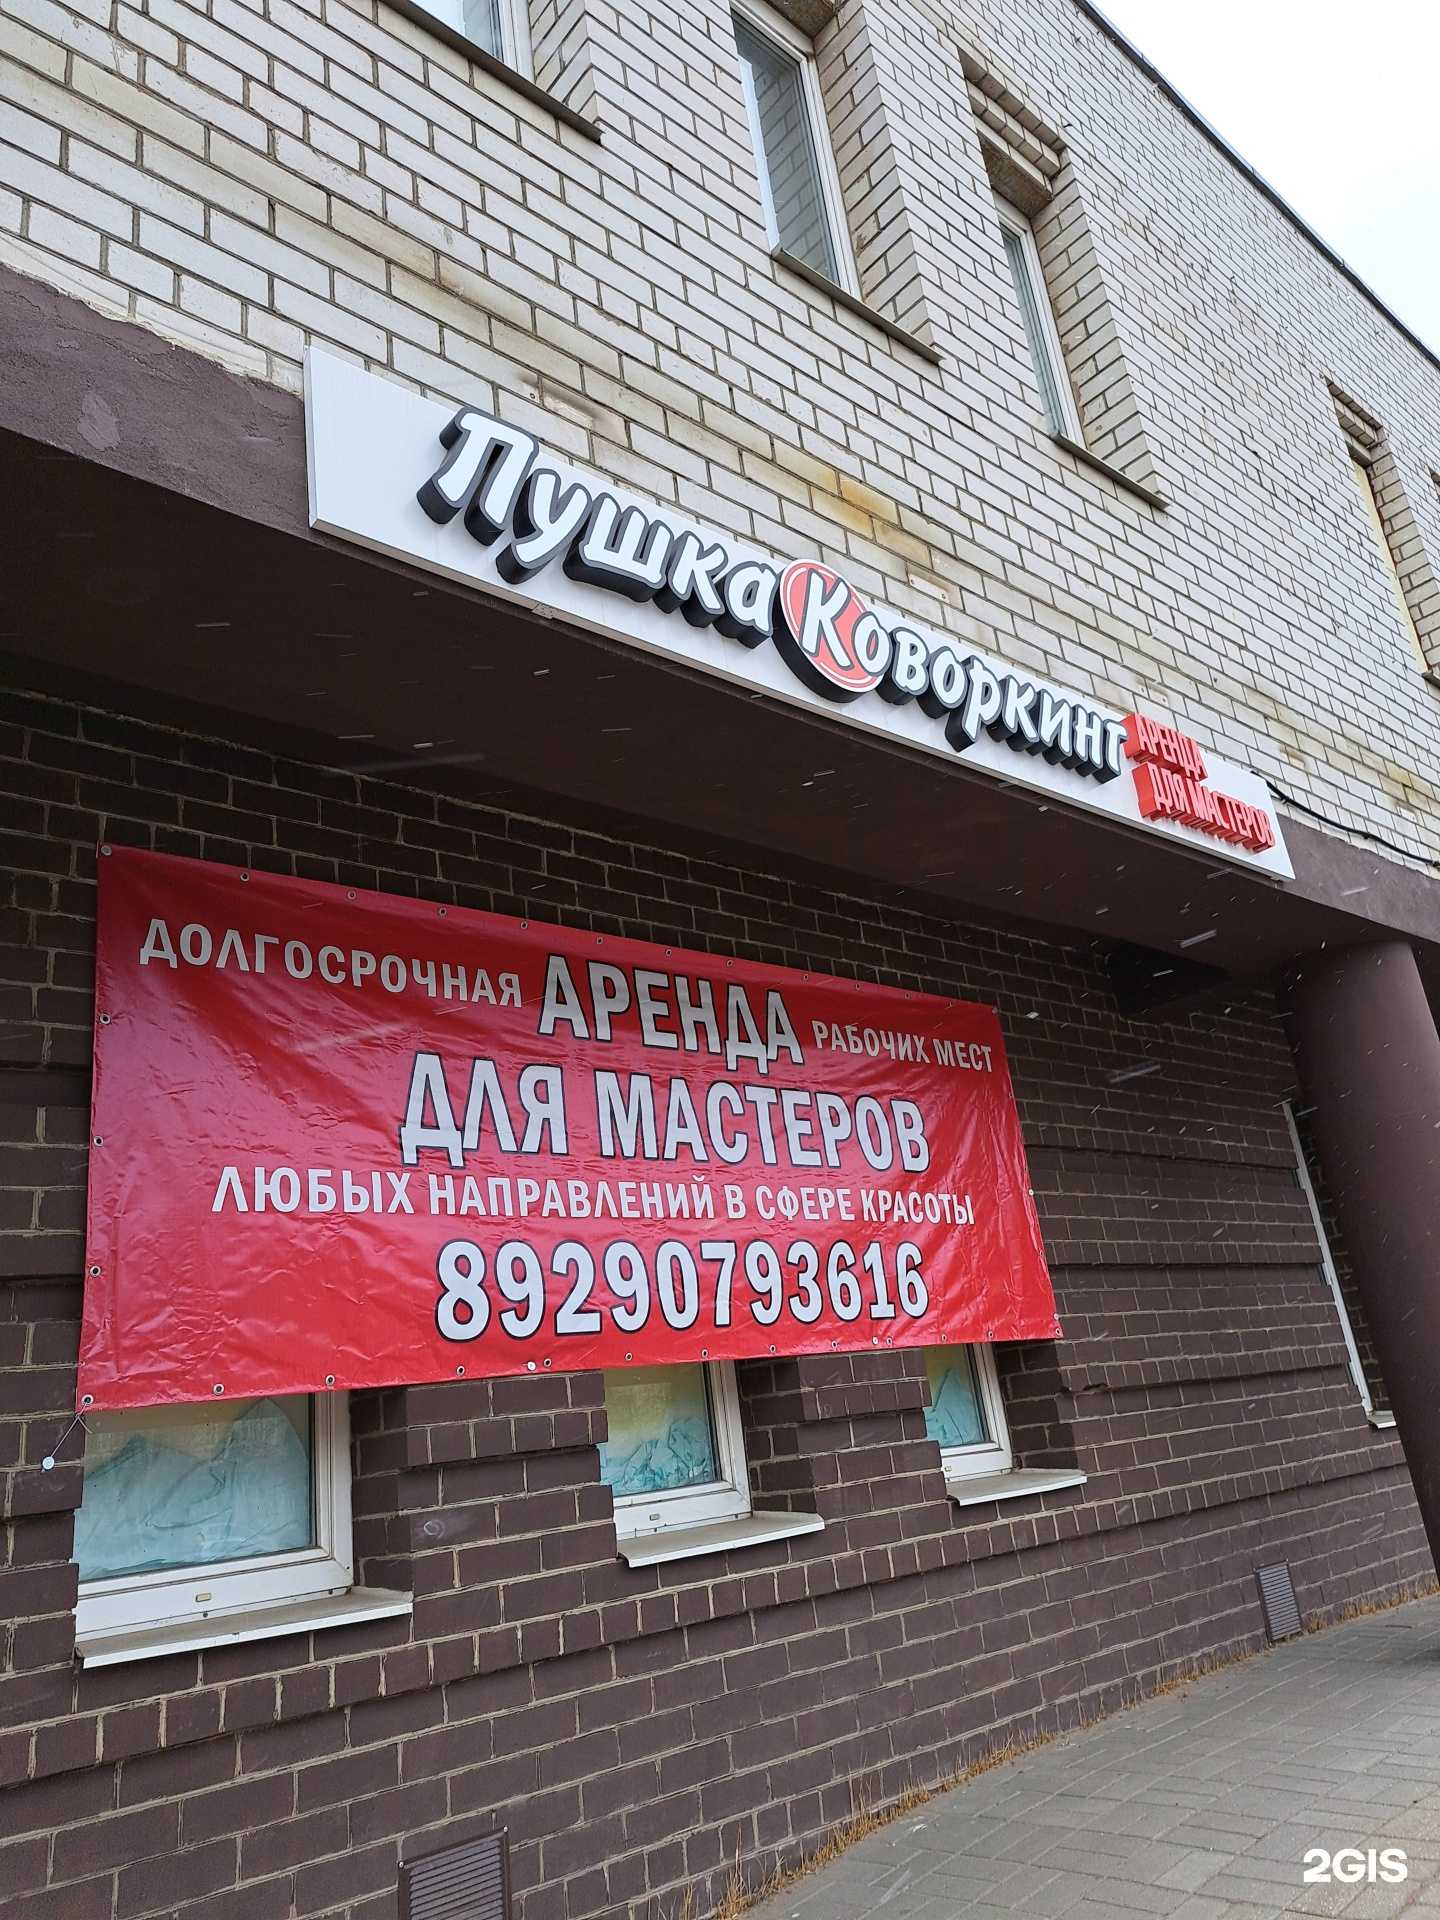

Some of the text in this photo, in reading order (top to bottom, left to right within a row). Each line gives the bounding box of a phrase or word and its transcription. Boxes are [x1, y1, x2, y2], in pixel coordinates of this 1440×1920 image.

[422, 406, 1128, 780] Пушка Коворкинг
[1130, 713, 1208, 782] АРЕНДА
[1140, 762, 1275, 850] ДЛЯ МАСТЕРОВ
[139, 918, 993, 1074] ДОЛГОСРОЧНАЯ АРЕНДА РАБОЧИХ МЕСТ
[399, 1052, 931, 1173] ДЛЯ МАСТЕРОВ
[211, 1166, 976, 1226] ЛЮБЫХ НАПРАВЛЕНИЙ В СФЕРЕ КРАСОТЫ
[435, 1238, 930, 1342] 89290793616
